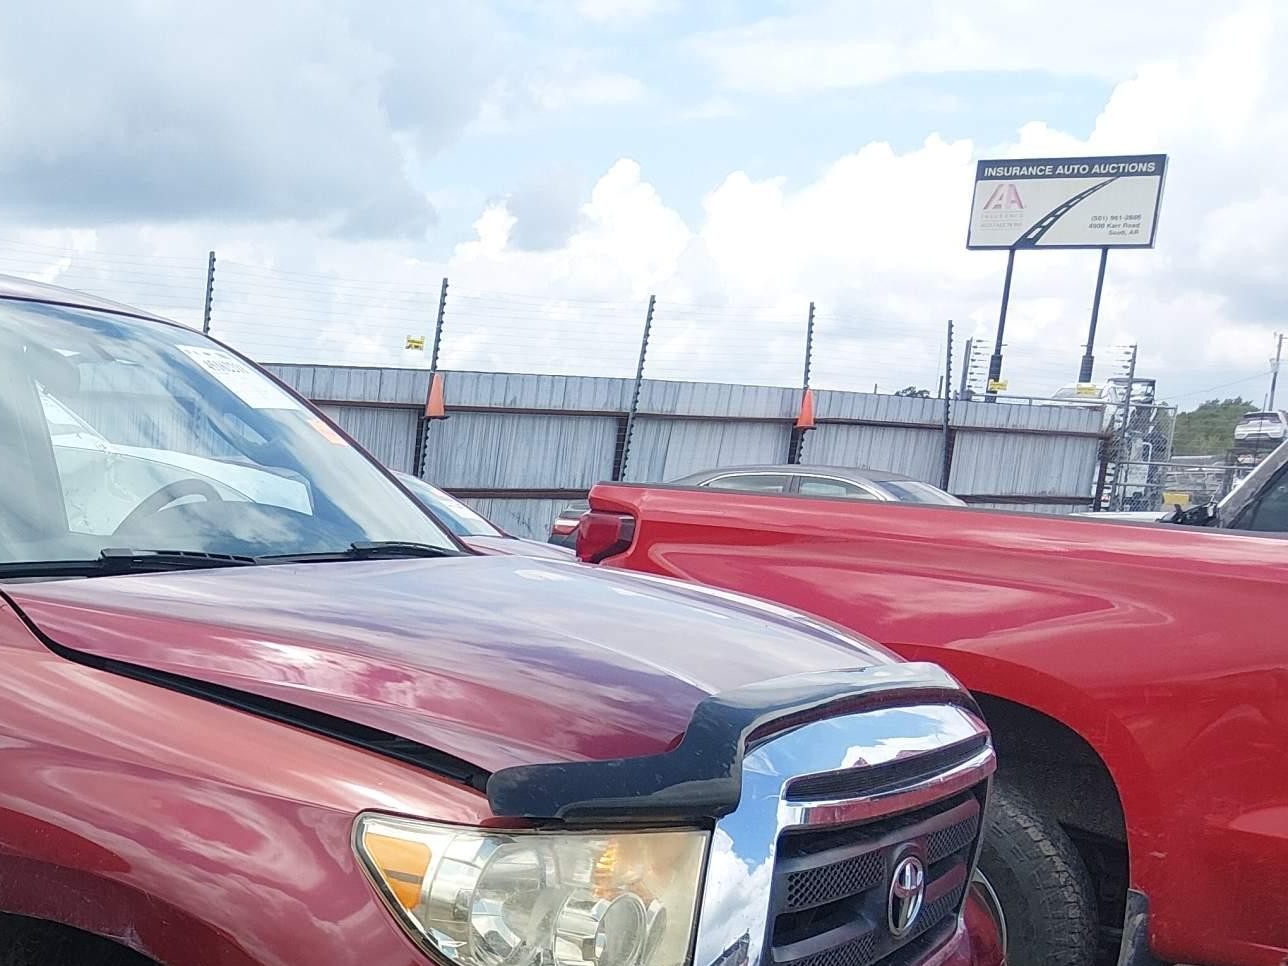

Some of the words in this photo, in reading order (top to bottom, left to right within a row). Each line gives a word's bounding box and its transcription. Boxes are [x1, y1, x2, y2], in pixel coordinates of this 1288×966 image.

[984, 164, 1053, 177] INSURANCE
[1056, 163, 1089, 175] AUTO
[1091, 162, 1156, 174] AUCTIONS
